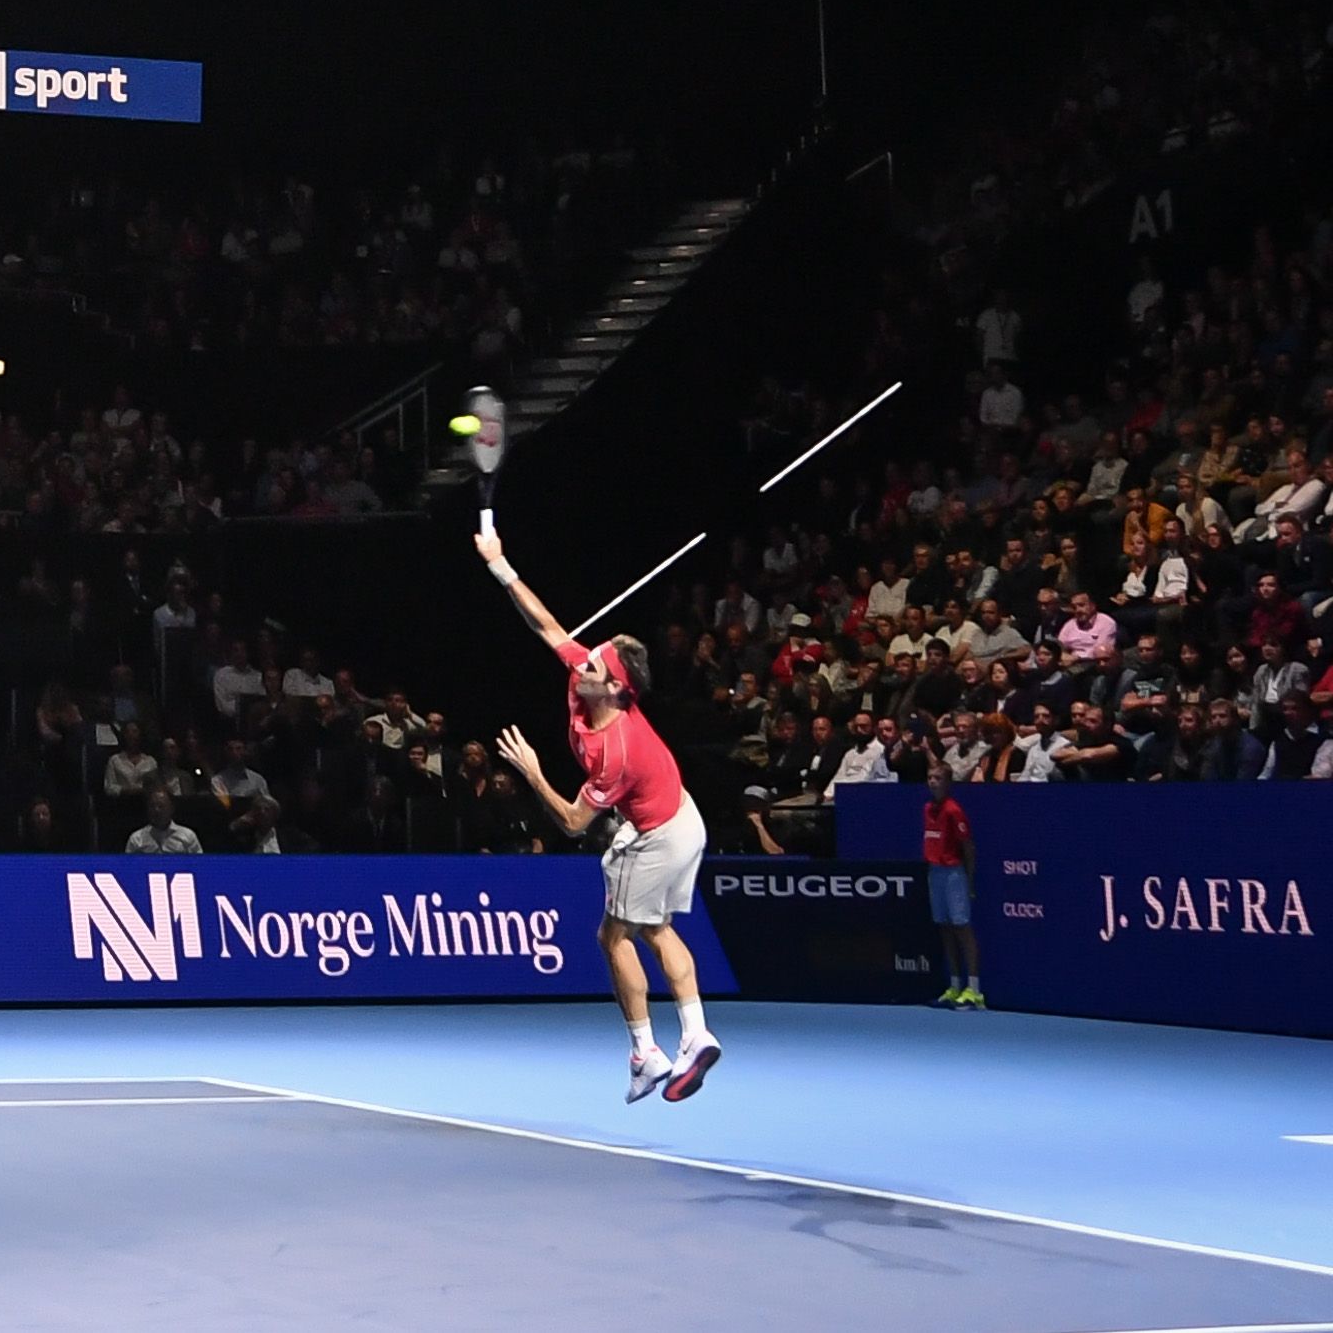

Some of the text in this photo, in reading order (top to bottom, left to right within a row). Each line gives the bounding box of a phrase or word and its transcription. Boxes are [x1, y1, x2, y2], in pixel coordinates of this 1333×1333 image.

[13, 64, 128, 108] sport
[1128, 188, 1173, 244] A1
[1003, 860, 1038, 875] SHOT
[714, 875, 914, 897] PEUGEOT
[1003, 902, 1044, 918] CLOCK
[1098, 874, 1315, 942] J. SAFRA
[214, 891, 563, 976] Norge Mining
[895, 954, 930, 972] km/h
